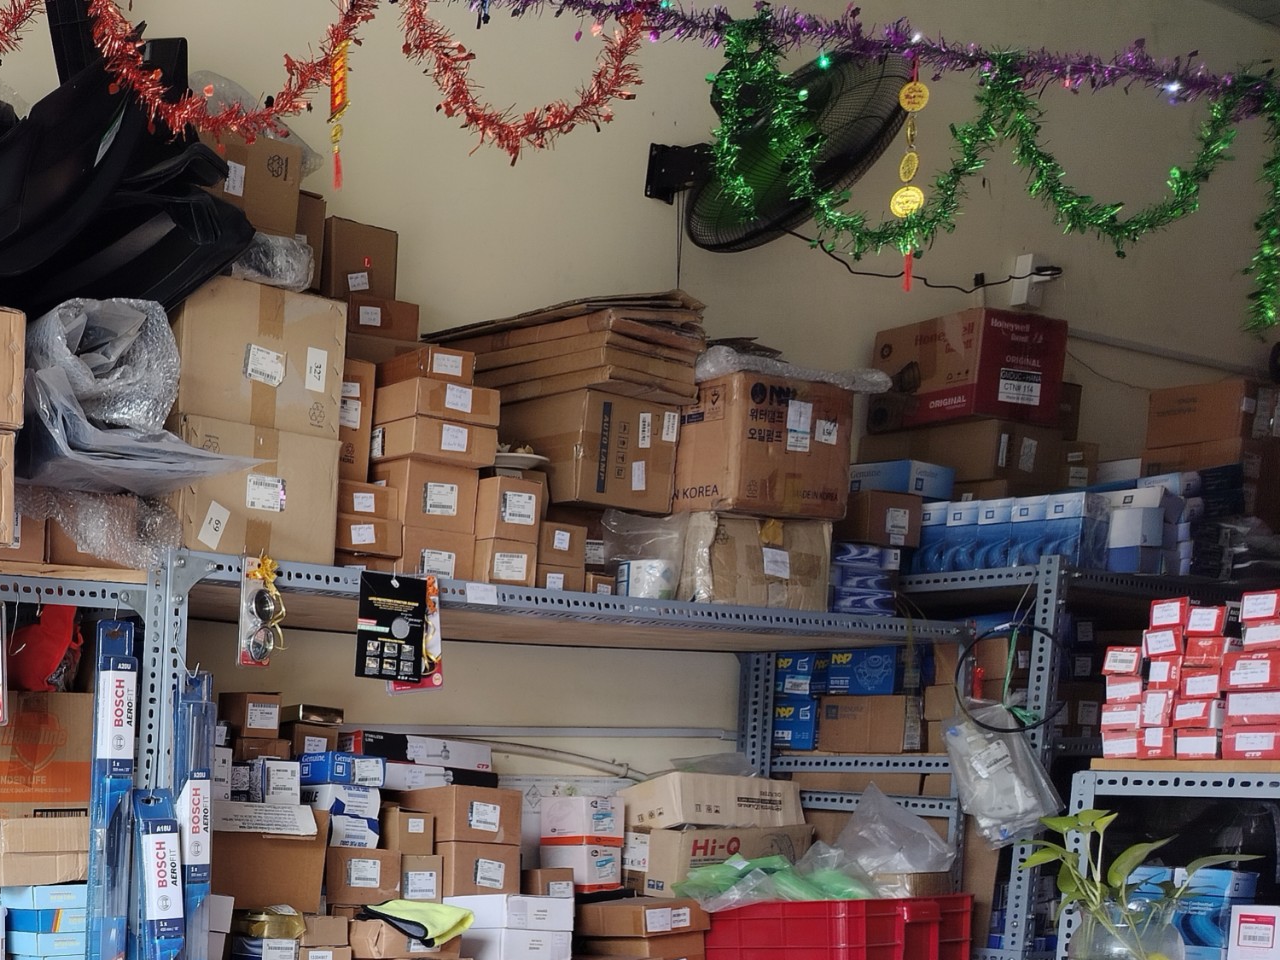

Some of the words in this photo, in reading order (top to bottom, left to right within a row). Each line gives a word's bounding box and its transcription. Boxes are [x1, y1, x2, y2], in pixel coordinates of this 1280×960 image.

[990, 317, 1031, 334] Honeywell
[313, 361, 322, 381] 327
[1005, 354, 1041, 368] ORIGINAL
[929, 395, 967, 409] ORIGINAL
[682, 484, 719, 500] KOREA
[114, 679, 126, 728] BOSCH
[126, 687, 135, 727] AEROFIT
[301, 754, 326, 763] Genuine
[28, 776, 47, 785] LIFE
[192, 787, 201, 835] BOSCH
[691, 836, 741, 857] Hi-Q
[155, 840, 167, 888] BOSCH
[170, 848, 179, 887] AEROFIT
